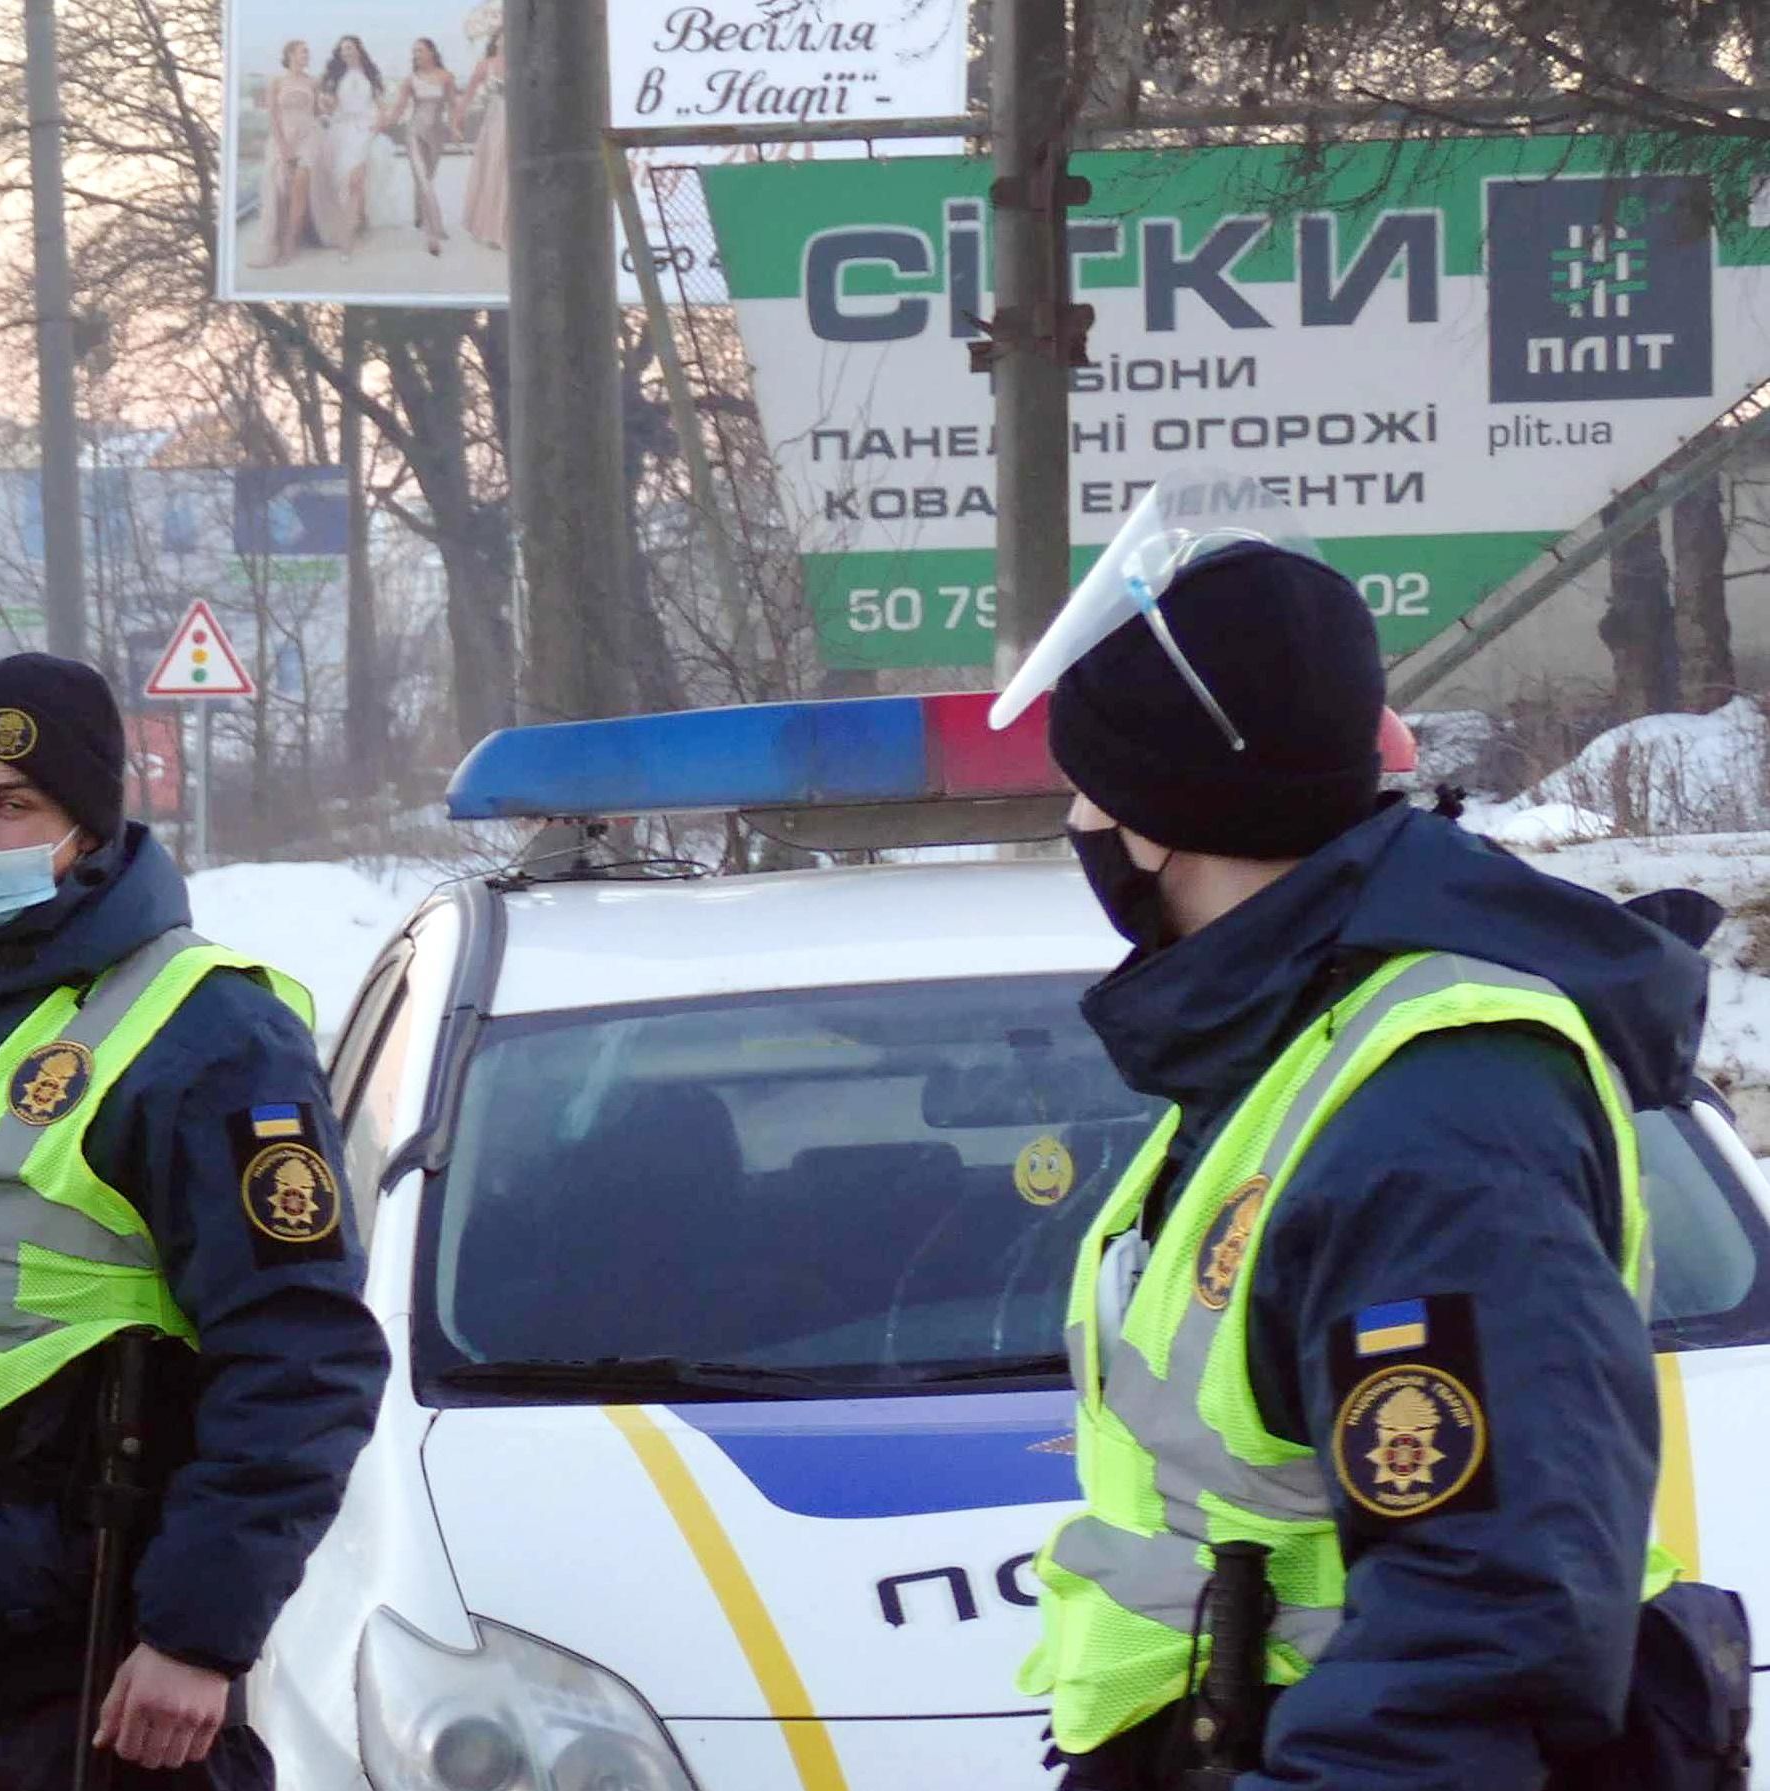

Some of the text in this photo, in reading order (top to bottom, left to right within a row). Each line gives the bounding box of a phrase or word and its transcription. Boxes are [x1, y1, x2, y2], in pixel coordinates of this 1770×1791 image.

[653, 6, 876, 52] Весілля
[1152, 403, 1438, 451] ОГОРОЖІ
[1489, 415, 1613, 456] plit.ua
